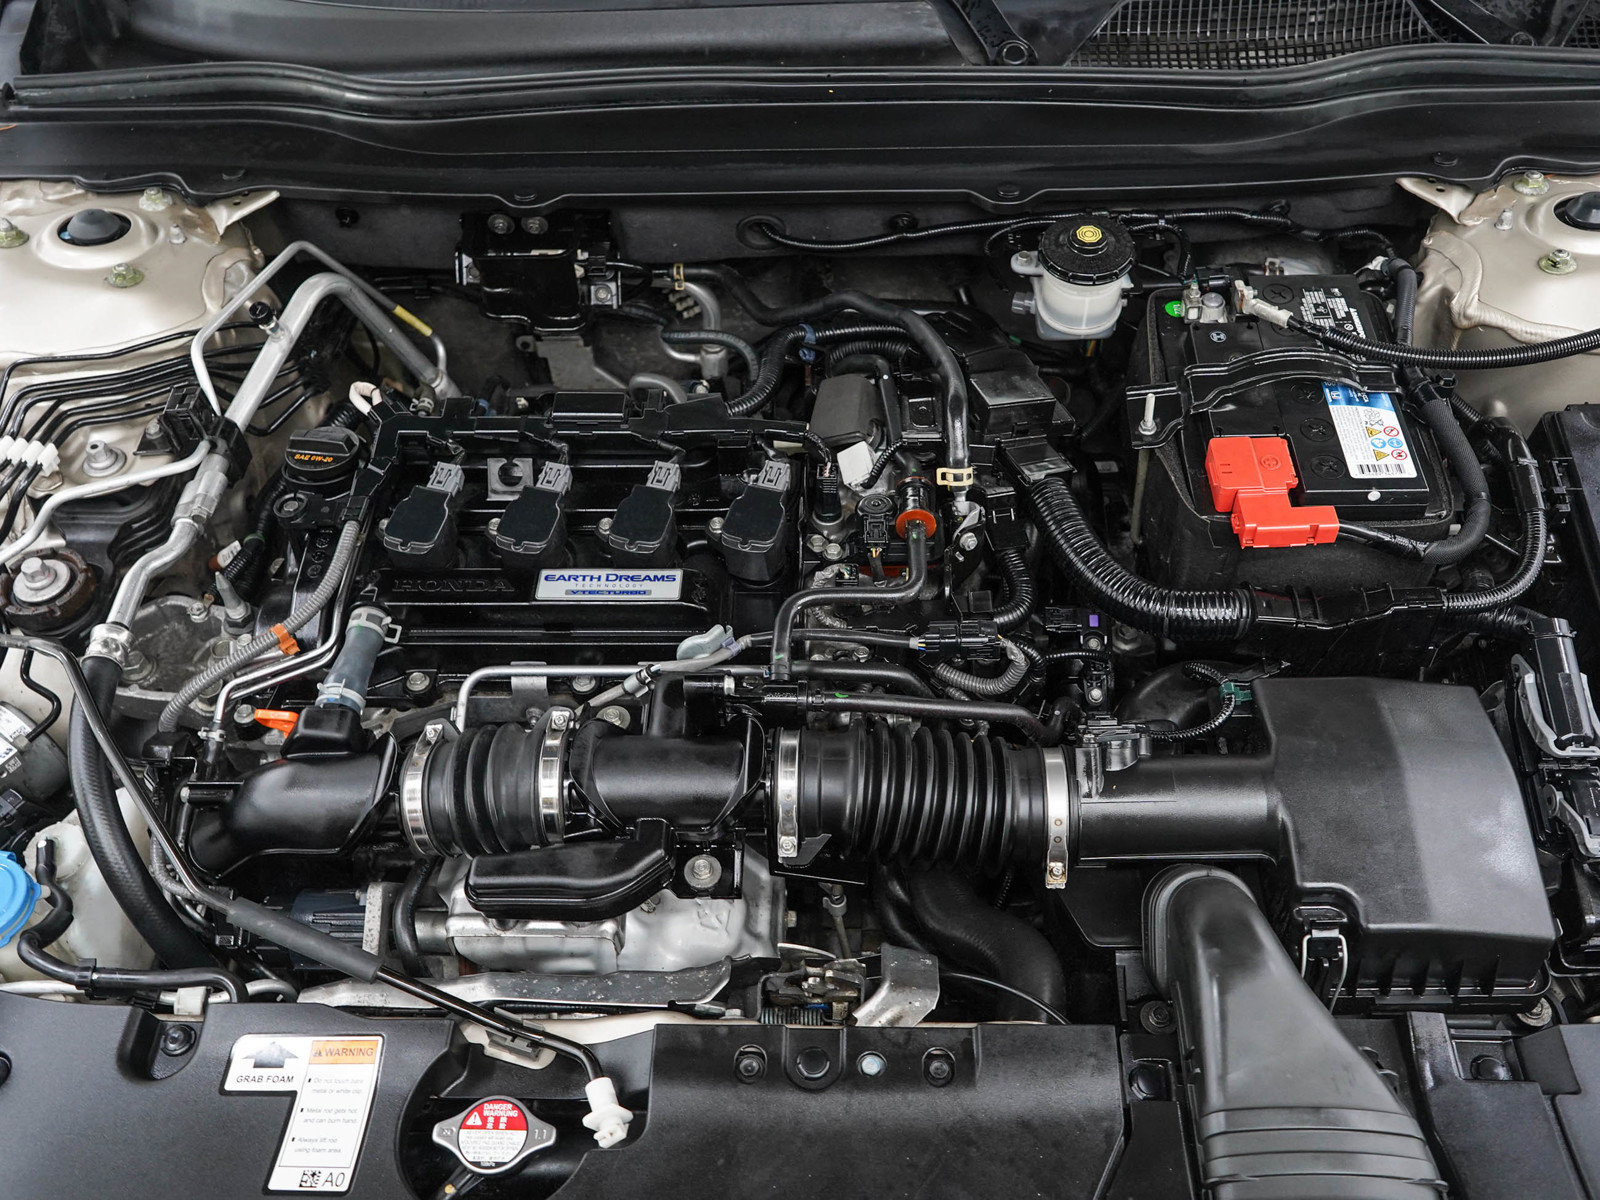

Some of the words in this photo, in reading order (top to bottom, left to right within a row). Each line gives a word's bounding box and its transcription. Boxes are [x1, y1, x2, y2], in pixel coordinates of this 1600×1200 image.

[310, 455, 334, 463] 0W-20
[544, 574, 601, 582] EARTH
[605, 573, 677, 582] DREAMS
[391, 579, 515, 592] HONDA
[324, 1047, 374, 1057] WARNING
[236, 1075, 264, 1083] GRAB
[266, 1075, 294, 1083] FOAM
[483, 1103, 513, 1111] DANGER
[534, 1129, 548, 1140] 1.1
